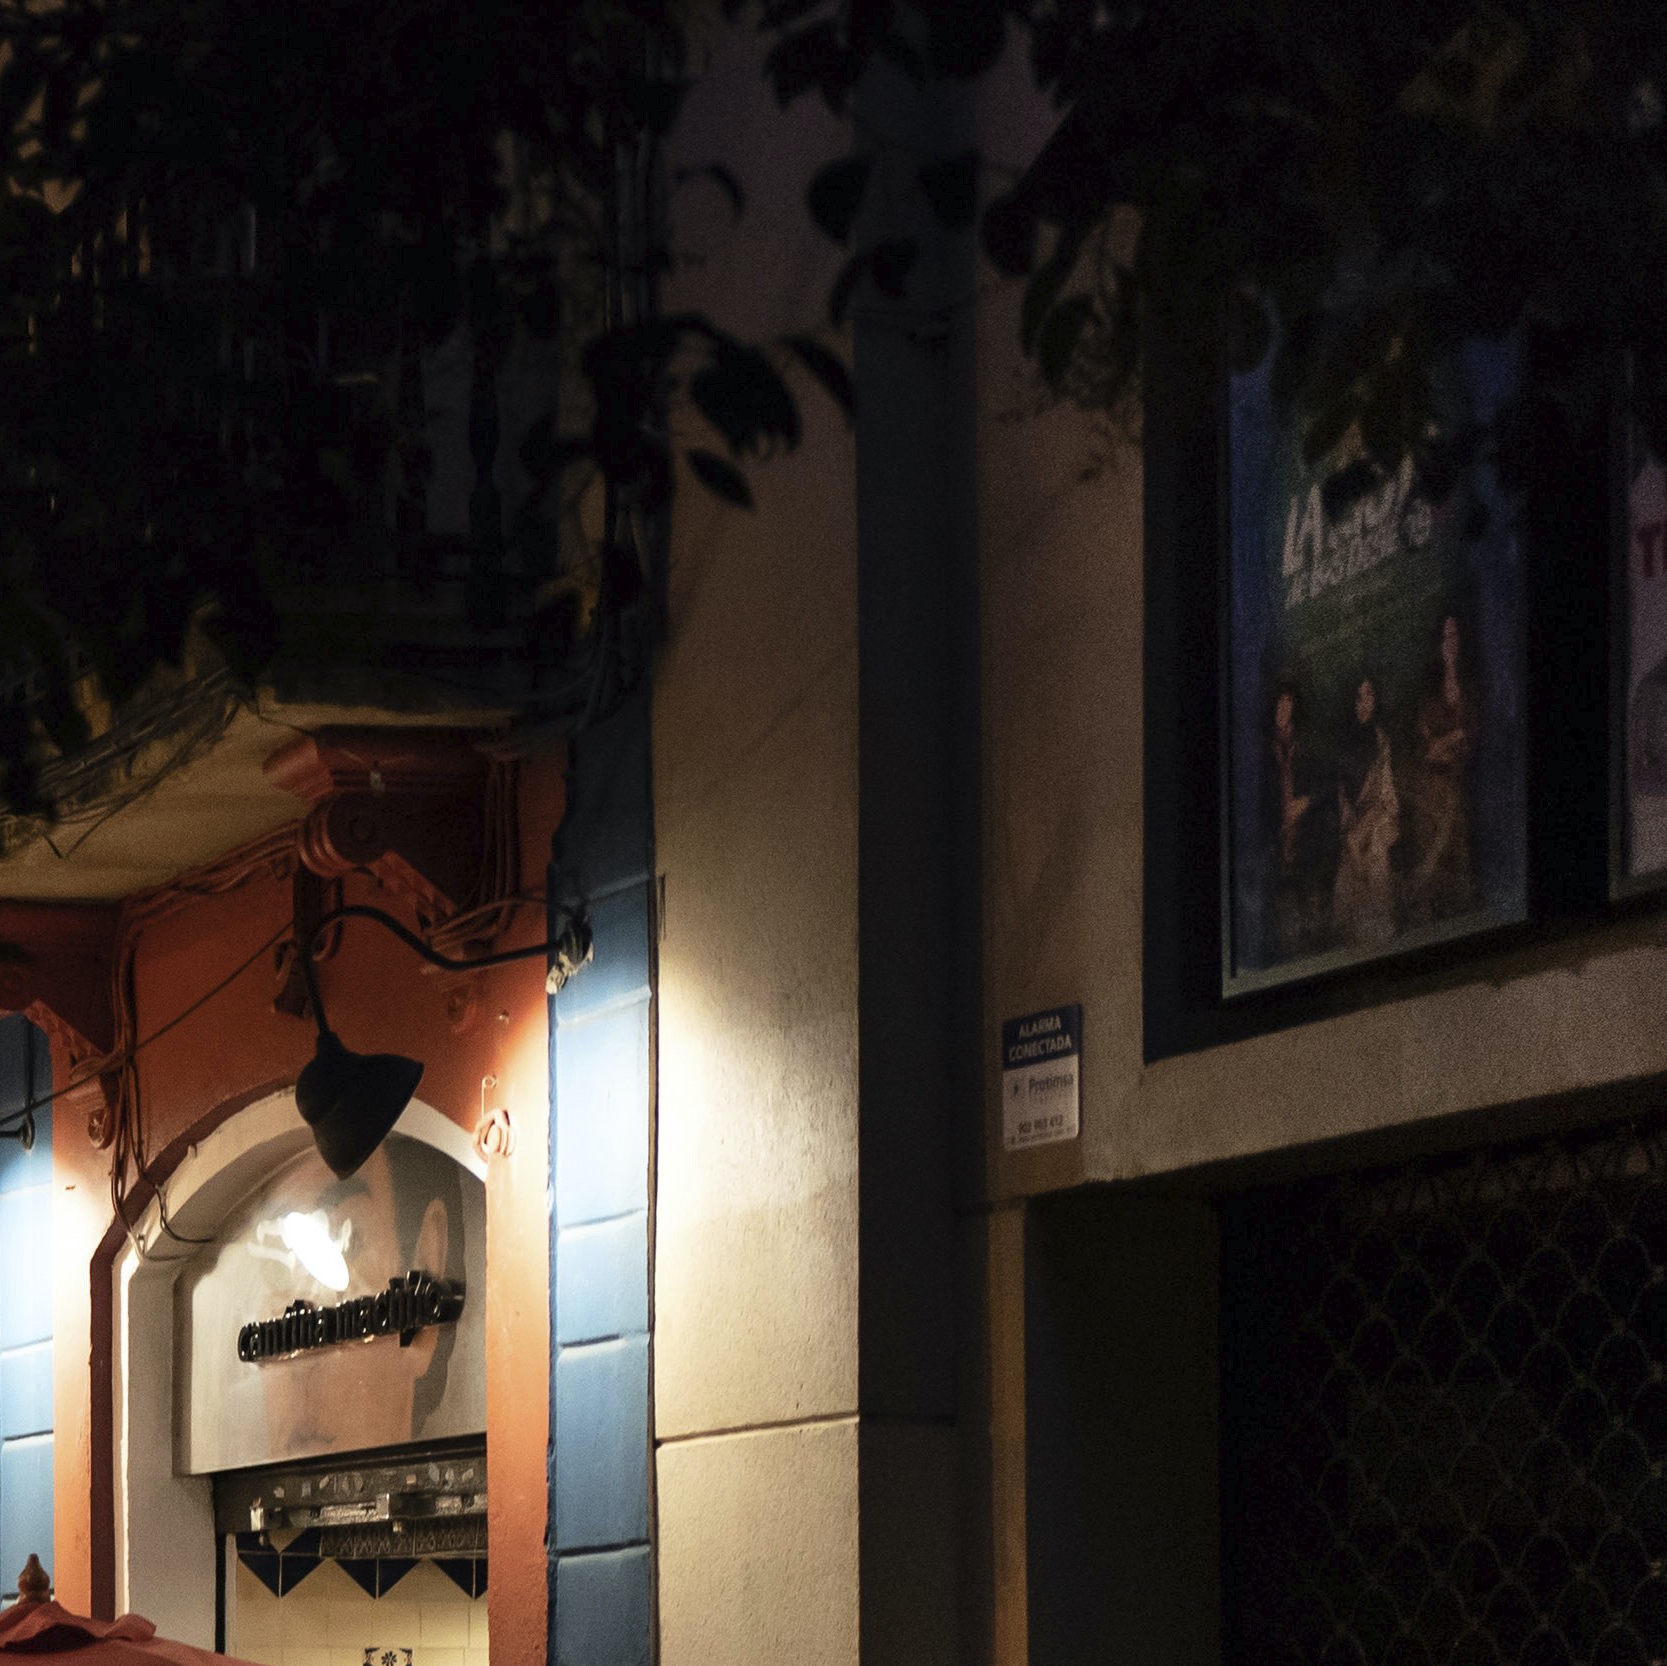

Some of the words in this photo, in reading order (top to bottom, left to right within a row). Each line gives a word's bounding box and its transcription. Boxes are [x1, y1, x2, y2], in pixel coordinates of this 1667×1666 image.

[1019, 1015, 1062, 1038] ALARMA
[1008, 1034, 1072, 1062] CONECTADA
[238, 1299, 331, 1361] cantina
